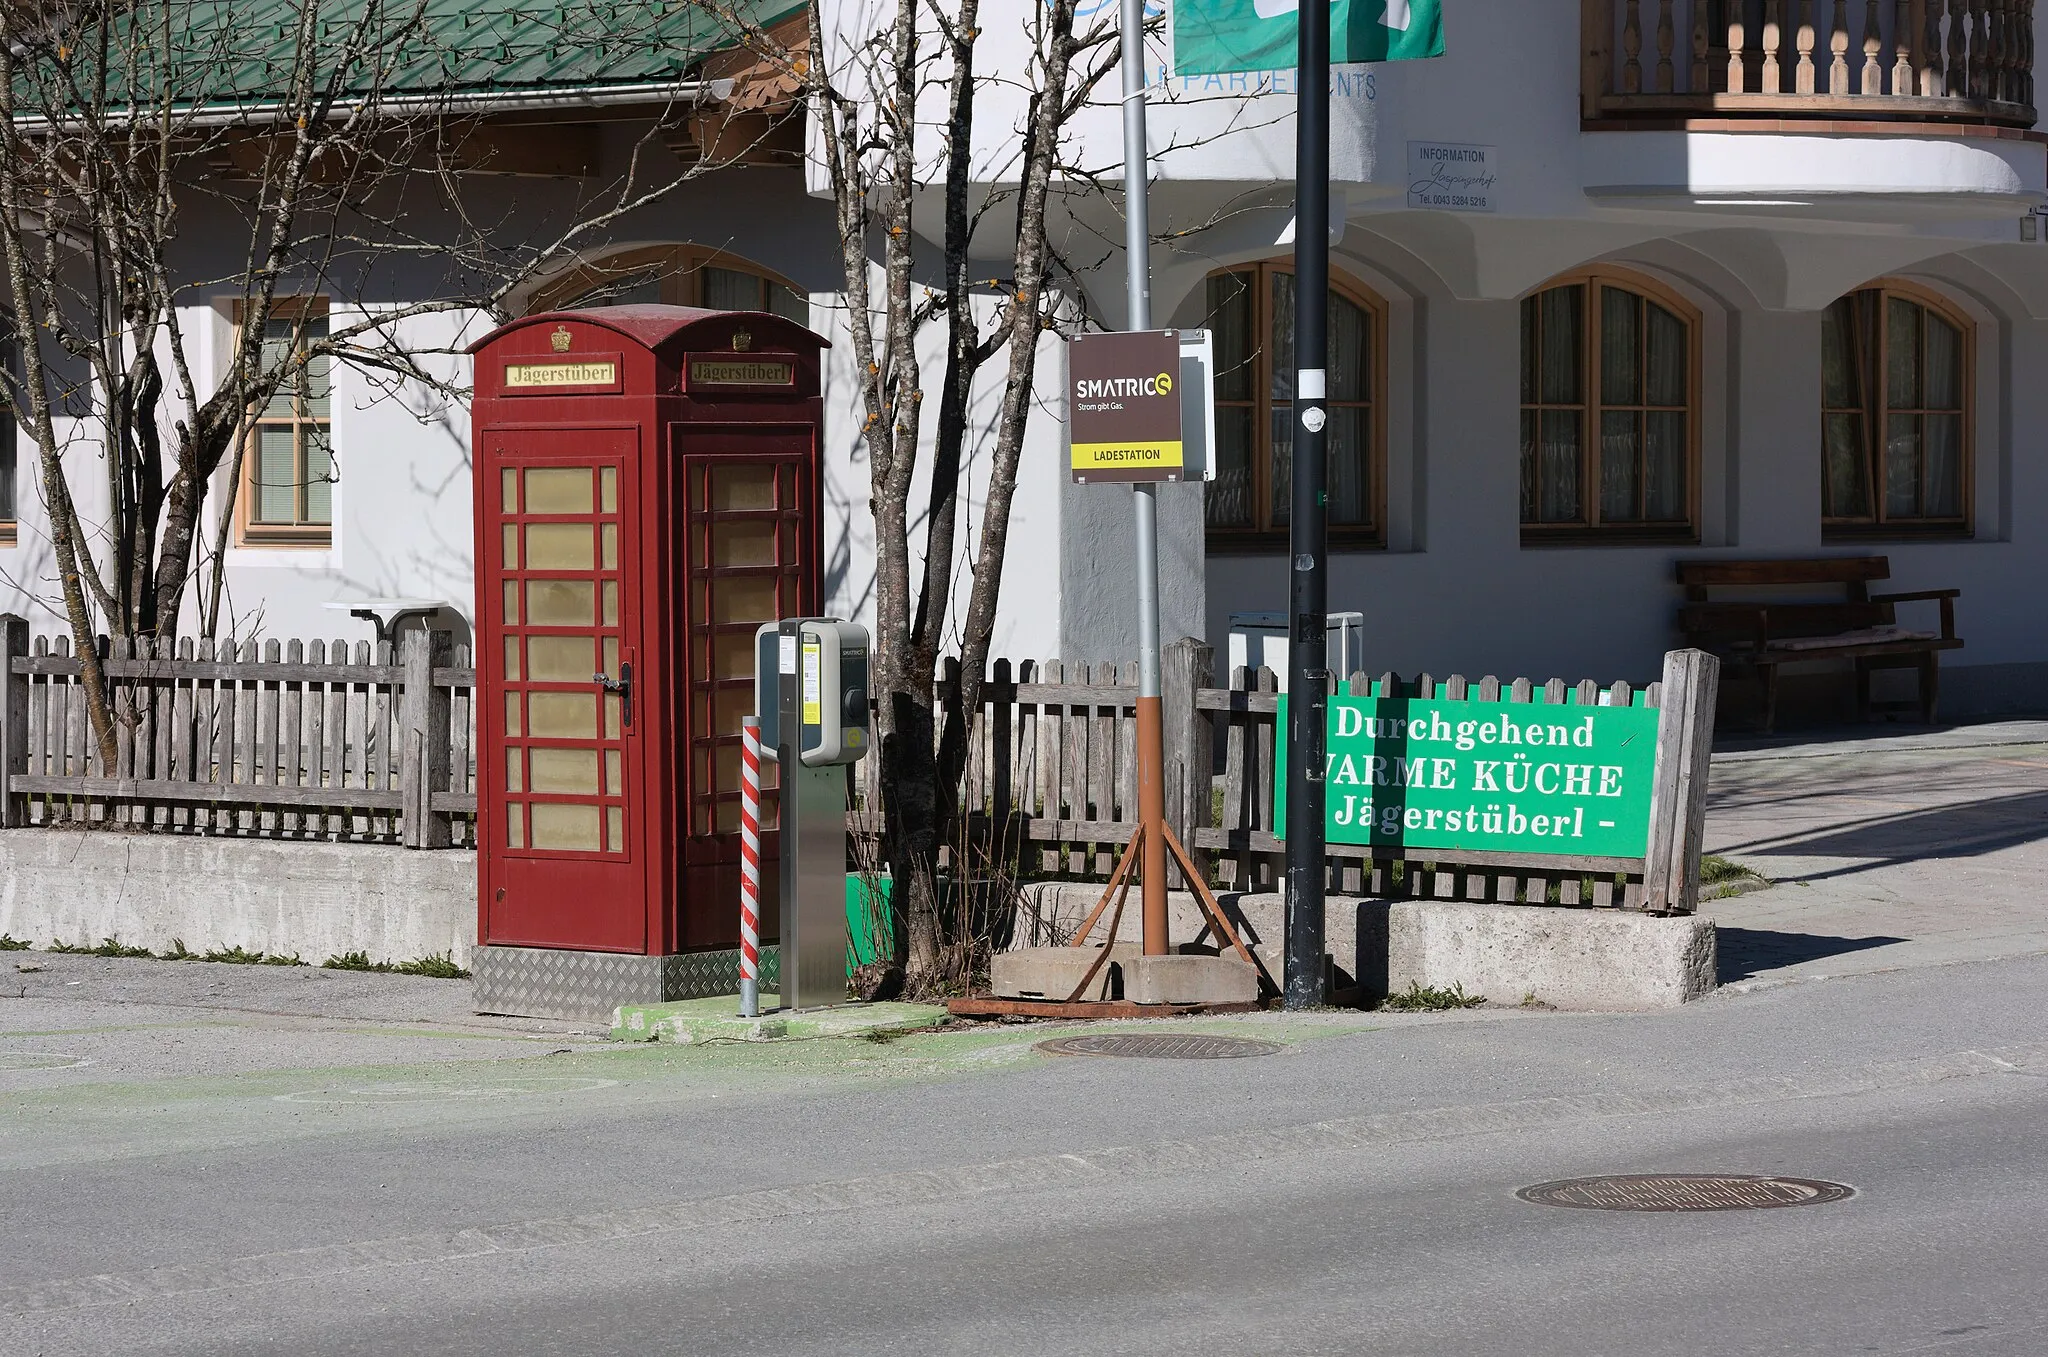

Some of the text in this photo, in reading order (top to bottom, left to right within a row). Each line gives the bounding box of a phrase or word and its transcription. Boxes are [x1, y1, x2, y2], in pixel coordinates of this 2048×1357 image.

[1420, 147, 1485, 163] INFORMATION
[1420, 194, 1487, 207] Tel. 0043 5284 5216
[514, 363, 613, 384] Jägerstüberl
[694, 362, 785, 382] Jägerstüberl
[1078, 402, 1124, 412] Strom gibt Gas.
[1094, 449, 1160, 461] LADESTATION
[1335, 706, 1594, 751] Durchgehend
[1472, 753, 1623, 798] KÜCHE
[1335, 796, 1583, 838] Jägerstüberl
